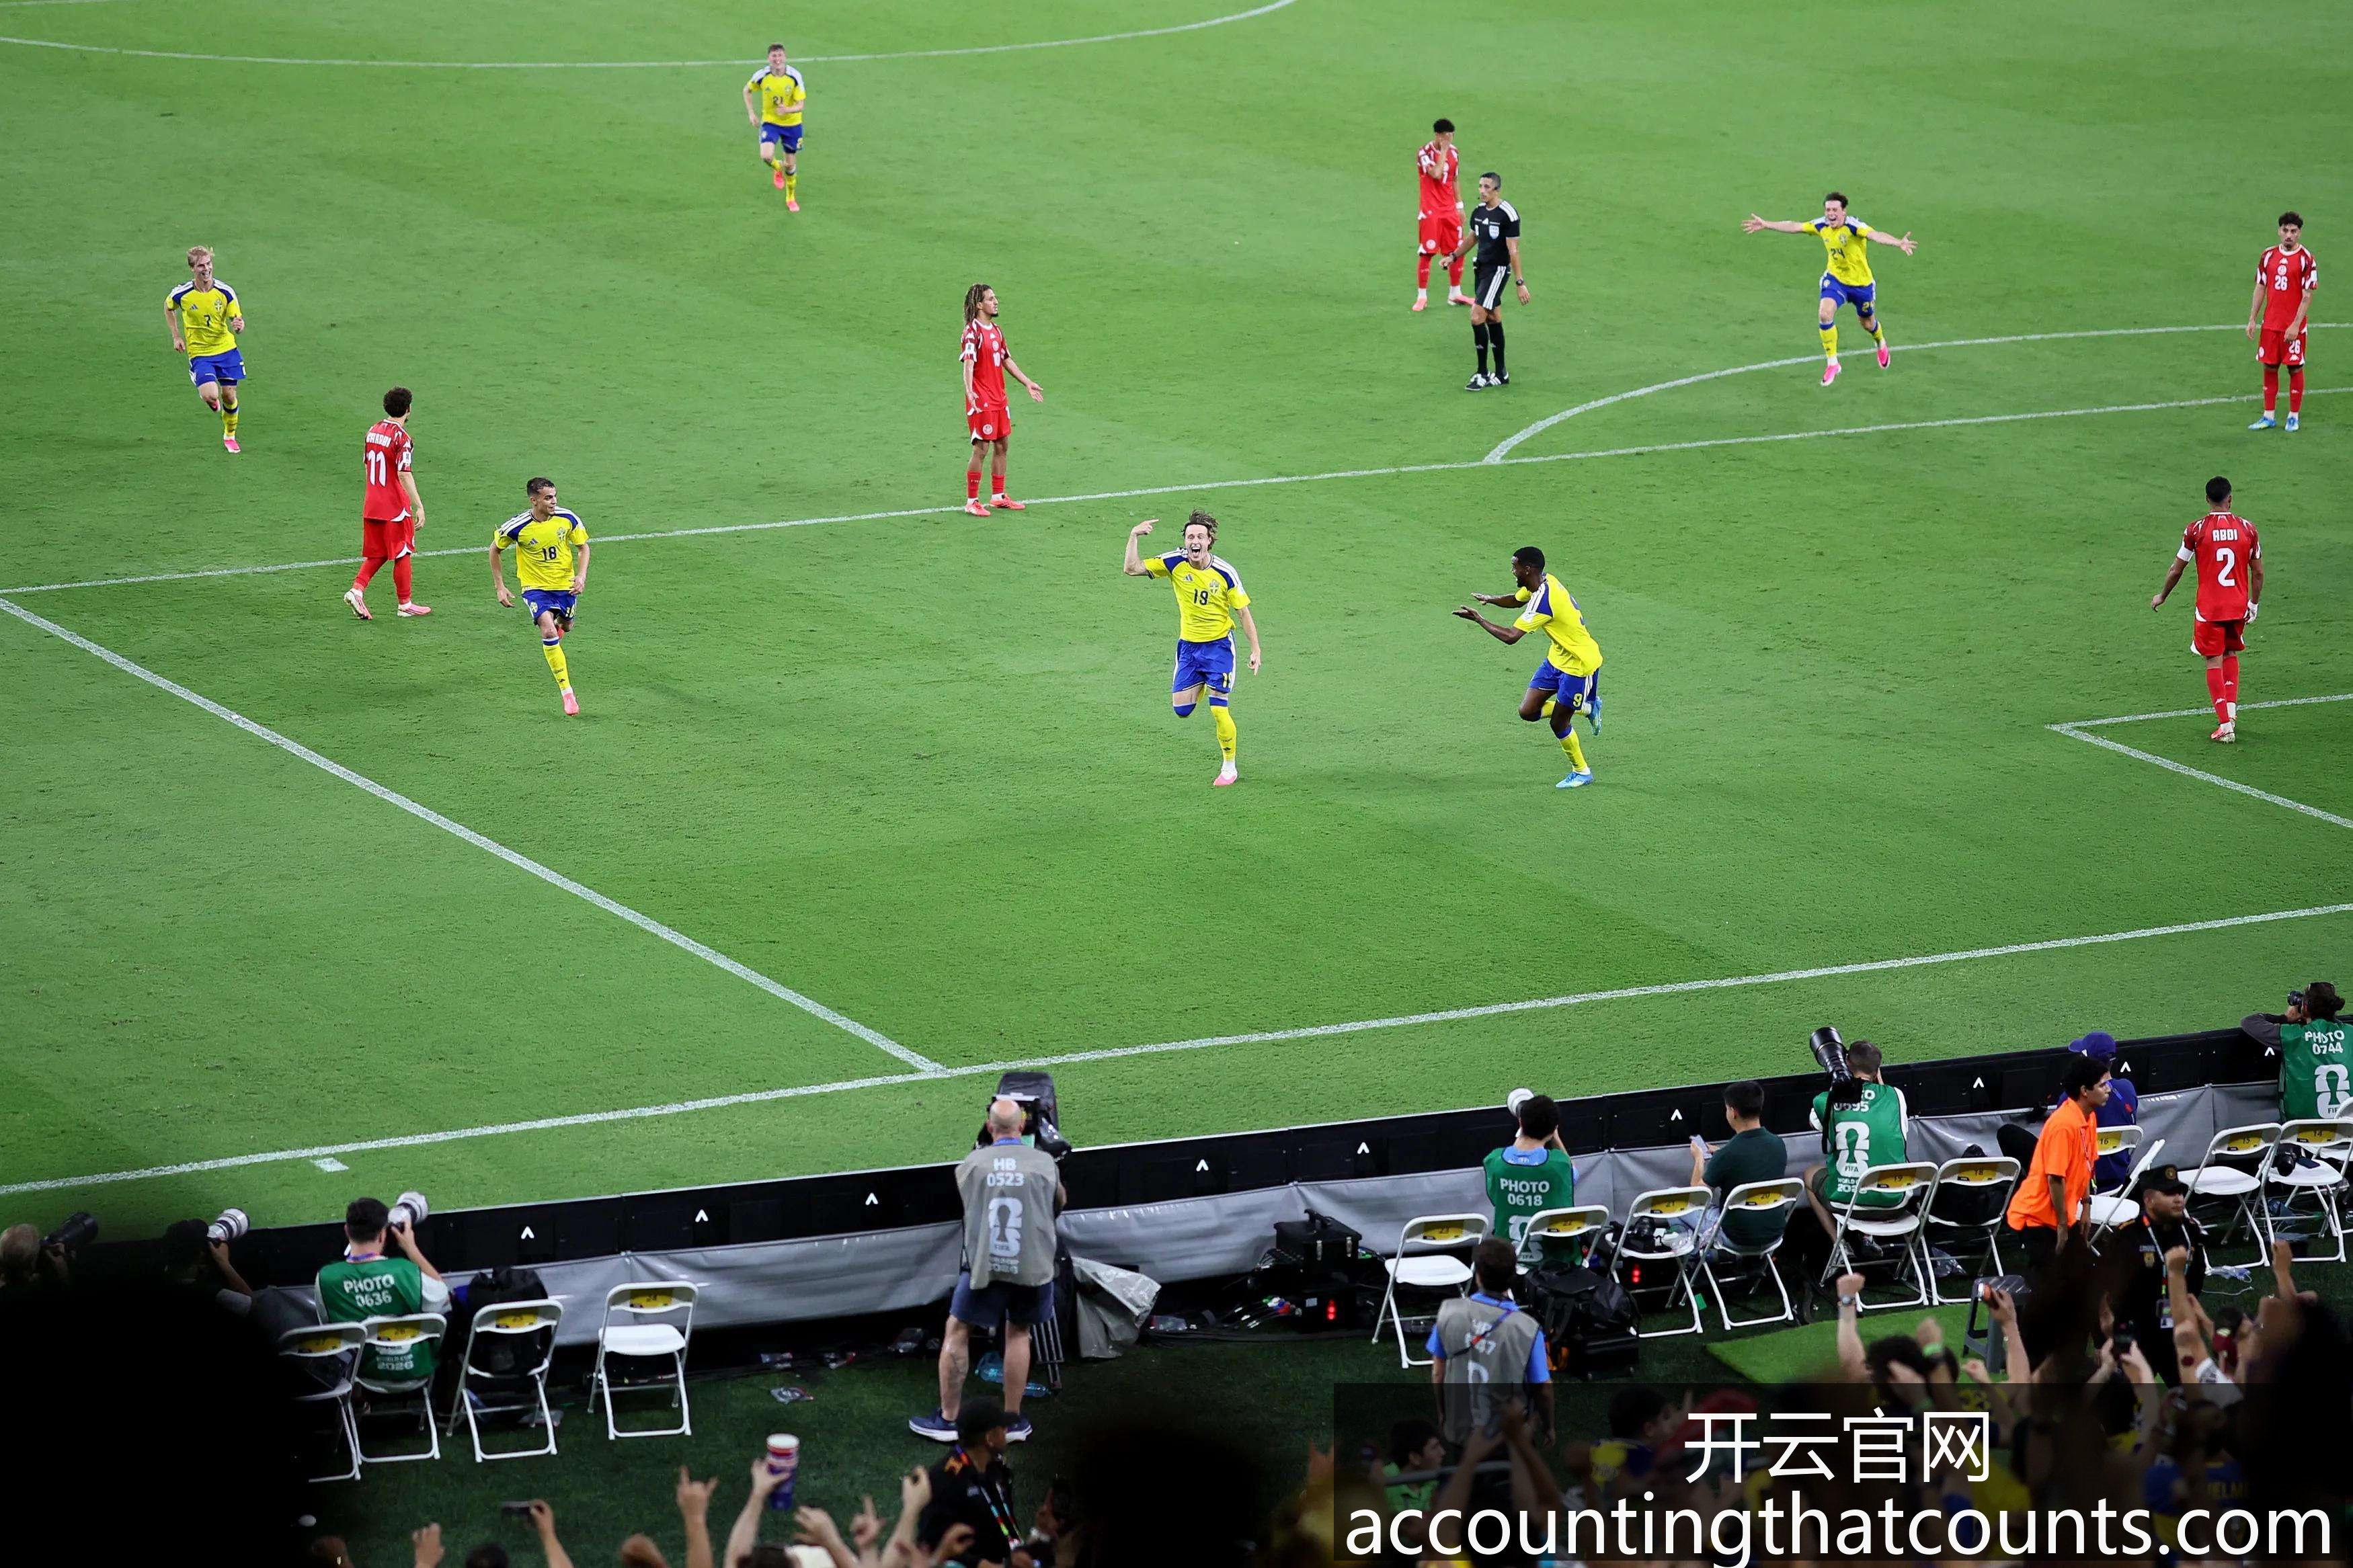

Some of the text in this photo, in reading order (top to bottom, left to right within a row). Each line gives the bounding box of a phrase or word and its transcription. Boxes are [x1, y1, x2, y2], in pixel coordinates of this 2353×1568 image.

[1830, 247, 1845, 260] 24
[2274, 276, 2288, 290] 26
[204, 314, 211, 327] 7
[2288, 339, 2301, 354] 26
[993, 352, 1000, 367] 10
[367, 450, 387, 487] 11
[2212, 528, 2238, 542] ABDI
[542, 546, 557, 561] 18
[2216, 547, 2235, 587] 2
[1194, 588, 1208, 606] 19
[1573, 693, 1583, 707] 9
[2305, 1030, 2345, 1043] PHOTO
[2312, 1042, 2344, 1055] 0744
[2100, 1137, 2109, 1145] 16
[993, 1157, 1016, 1171] HB
[986, 1173, 1025, 1187] 0523
[1500, 1178, 1550, 1193] PHOTO
[1507, 1194, 1543, 1206] 0618
[343, 1274, 395, 1294] PHOTO
[355, 1290, 392, 1307] 0636
